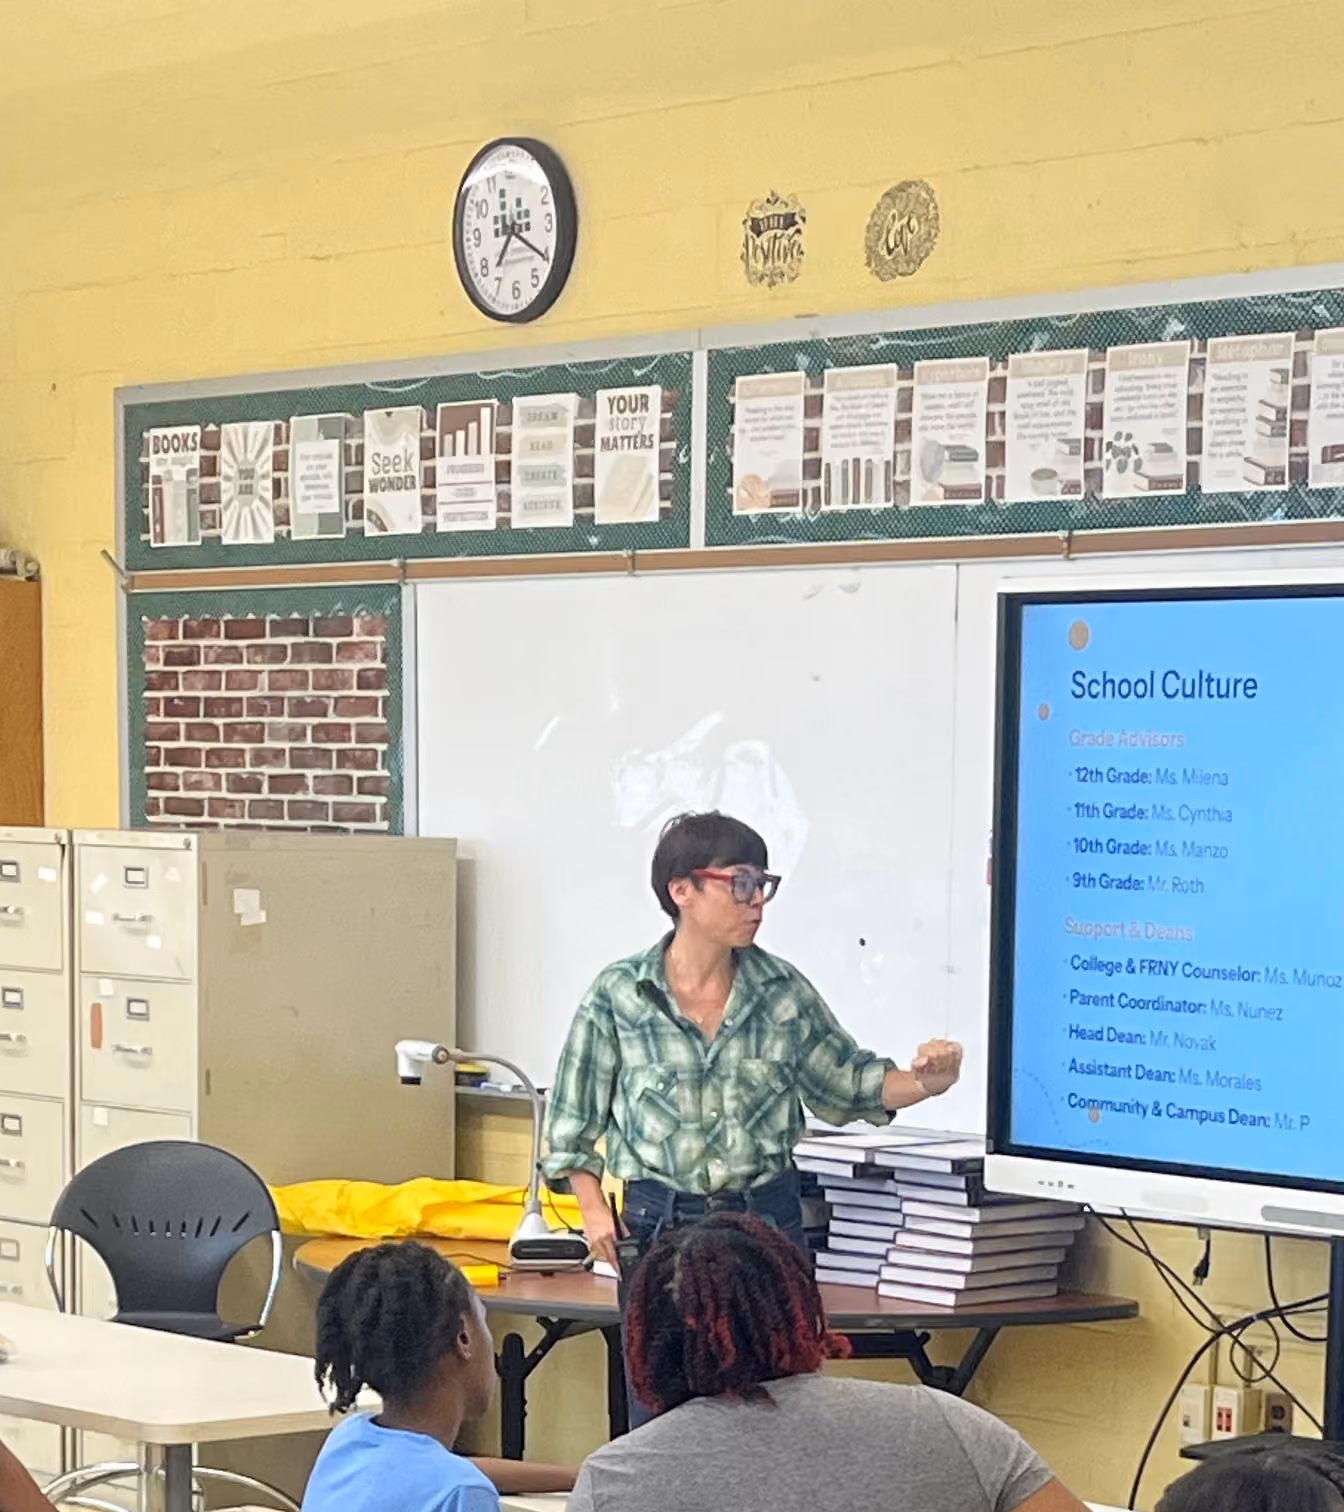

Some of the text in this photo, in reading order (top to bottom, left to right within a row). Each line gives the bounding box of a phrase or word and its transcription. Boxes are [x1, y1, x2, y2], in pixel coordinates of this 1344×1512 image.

[540, 186, 549, 205] 2
[476, 199, 488, 219] 10
[544, 213, 553, 233] 3
[473, 228, 481, 248] 9
[480, 258, 489, 277] 8
[531, 268, 540, 288] 5
[494, 277, 503, 296] 7
[511, 281, 521, 300] 6
[608, 393, 650, 415] YOUR
[608, 414, 646, 433] story
[152, 432, 199, 455] BOOKS
[600, 433, 654, 453] MATTERS
[371, 448, 416, 476] Seek
[368, 475, 417, 495] WONDER
[1071, 669, 1258, 700] School Culture
[1069, 728, 1185, 748] Grade Advisors
[1075, 766, 1229, 787] 12th Grade: Ms. Milena
[1074, 802, 1233, 824] 11th Grade: Ms. Cynthia
[1073, 837, 1229, 859] 10th Grade: Ms. Manzo
[1072, 872, 1205, 894] 9th Grade: Mr. Roth
[1064, 917, 1194, 942] Support & Deans
[1070, 954, 1123, 977] College
[1125, 958, 1136, 975] &
[1139, 959, 1179, 977] FRNY
[1181, 961, 1261, 983] Counselor:
[1264, 966, 1289, 985] Ms.
[1069, 989, 1115, 1006] Parent
[1117, 992, 1207, 1014] Coordinator:
[1210, 999, 1235, 1018] Ms.
[1068, 1024, 1217, 1052] Head Dean: Mr. Novak
[1068, 1058, 1262, 1092] Assistant Dean: Ms. Morales
[1067, 1092, 1311, 1132] Community & Campus Dean: Mr. P
